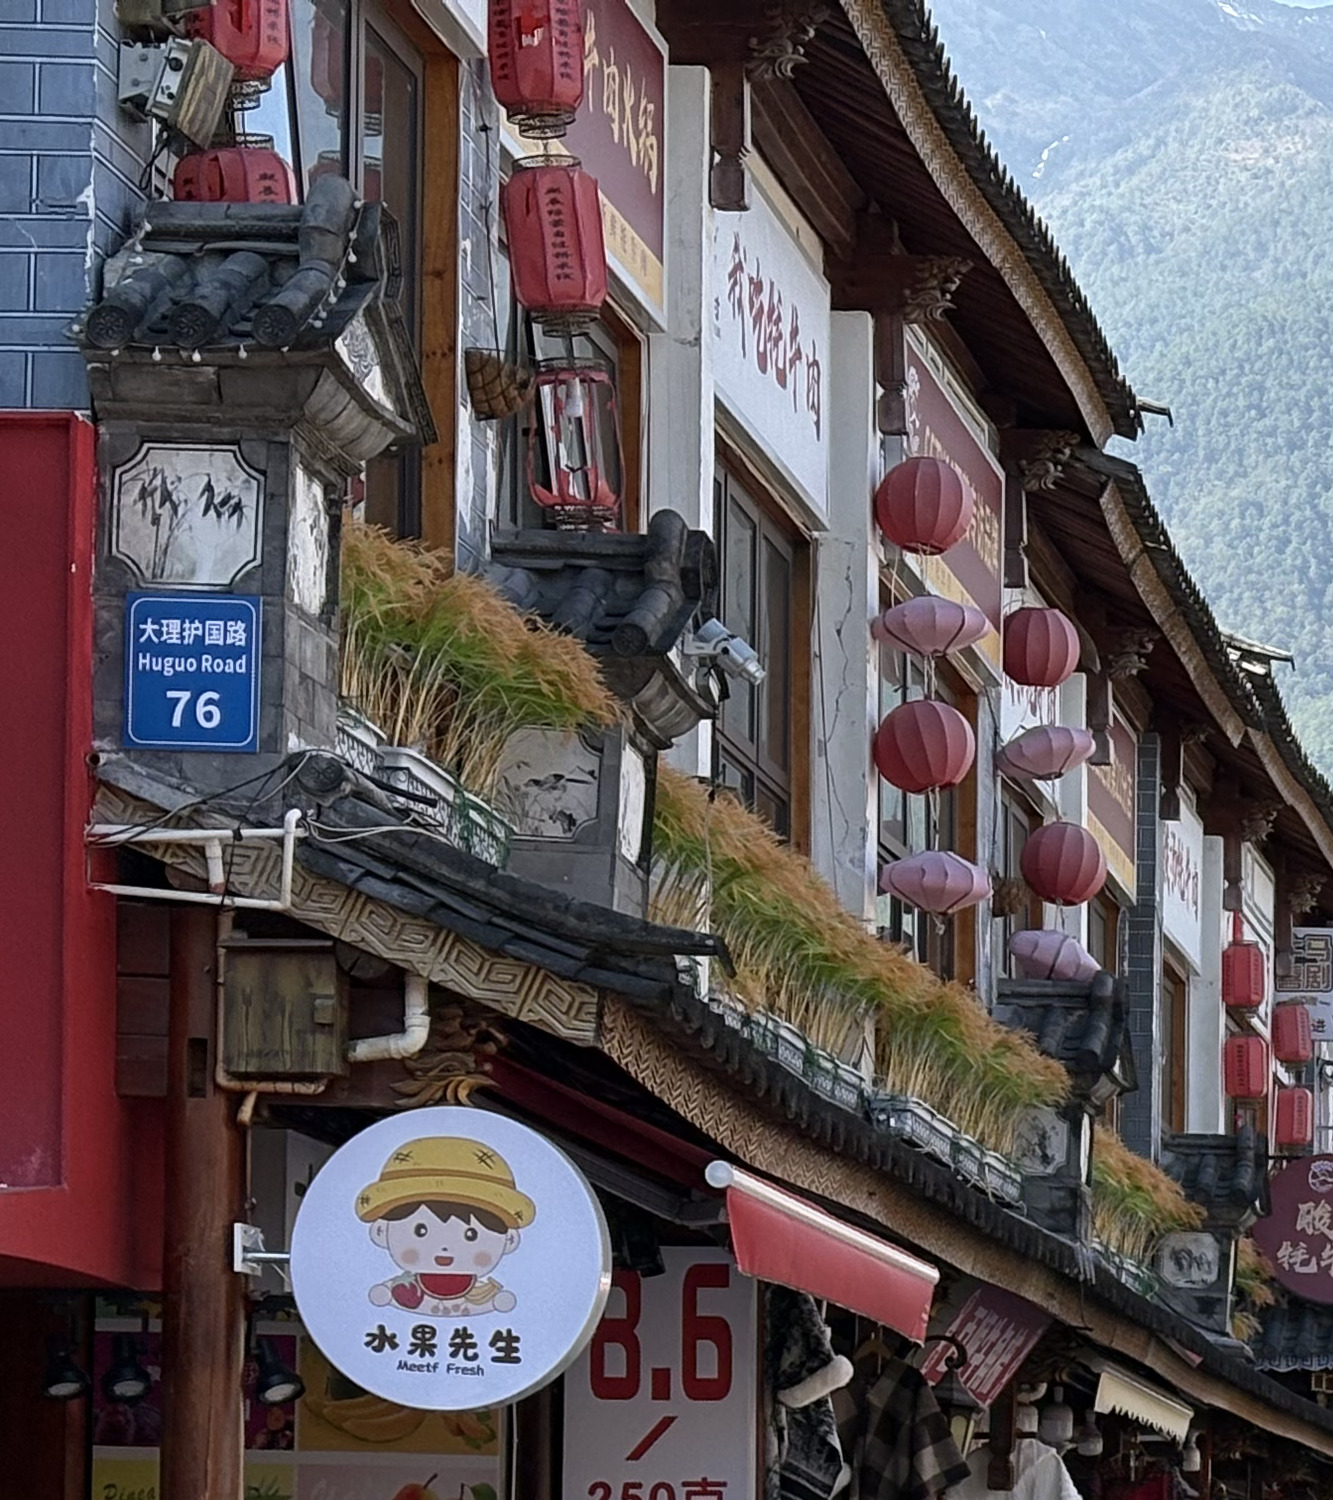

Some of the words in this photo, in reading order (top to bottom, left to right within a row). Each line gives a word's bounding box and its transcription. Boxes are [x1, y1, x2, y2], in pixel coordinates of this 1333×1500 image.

[138, 617, 247, 646] 大理护国路
[138, 652, 197, 676] Huguo
[201, 654, 247, 674] Road
[166, 690, 221, 728] 76
[364, 1324, 522, 1364] 水果先生
[589, 1263, 733, 1401] 8.6
[446, 1363, 485, 1377] Fresh
